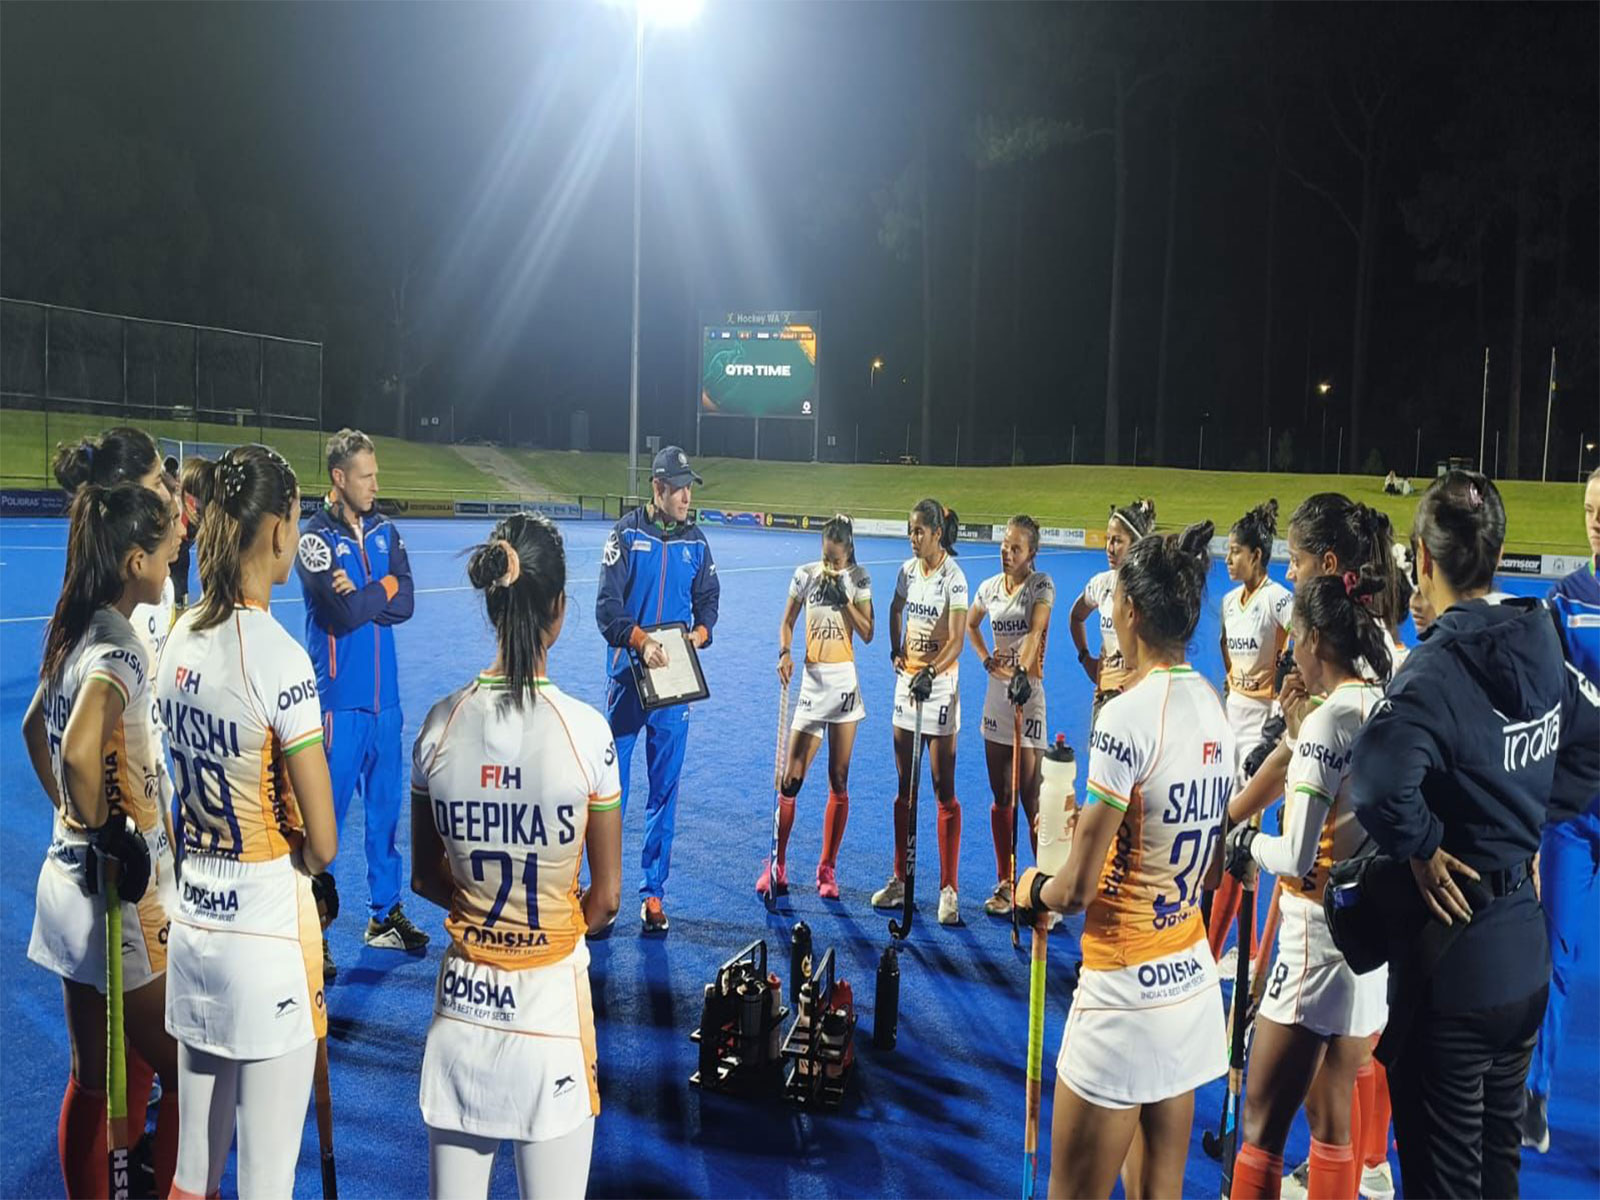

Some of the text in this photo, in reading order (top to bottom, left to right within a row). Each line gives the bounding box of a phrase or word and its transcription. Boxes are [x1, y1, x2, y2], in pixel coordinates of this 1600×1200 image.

[737, 313, 780, 324] Hockey WA
[725, 364, 791, 376] QTR TIME
[1498, 559, 1540, 569] eamstar
[992, 619, 1028, 631] ODISHA
[1228, 636, 1258, 650] DISHA
[101, 648, 145, 686] DISH
[278, 679, 318, 711] ODIS
[840, 691, 855, 713] 27
[157, 698, 241, 758] AKSHI
[938, 705, 949, 726] 6
[1024, 718, 1042, 740] 20
[1300, 741, 1344, 773] DISHA
[480, 764, 521, 790] FIH
[1163, 776, 1231, 825] SALIM
[434, 798, 576, 847] DEEPIKA S
[183, 881, 239, 911] ODISHA
[469, 849, 542, 931] 21
[463, 925, 549, 947] ODISHA
[443, 970, 515, 1009] ODISHA
[1269, 962, 1289, 1000] 8
